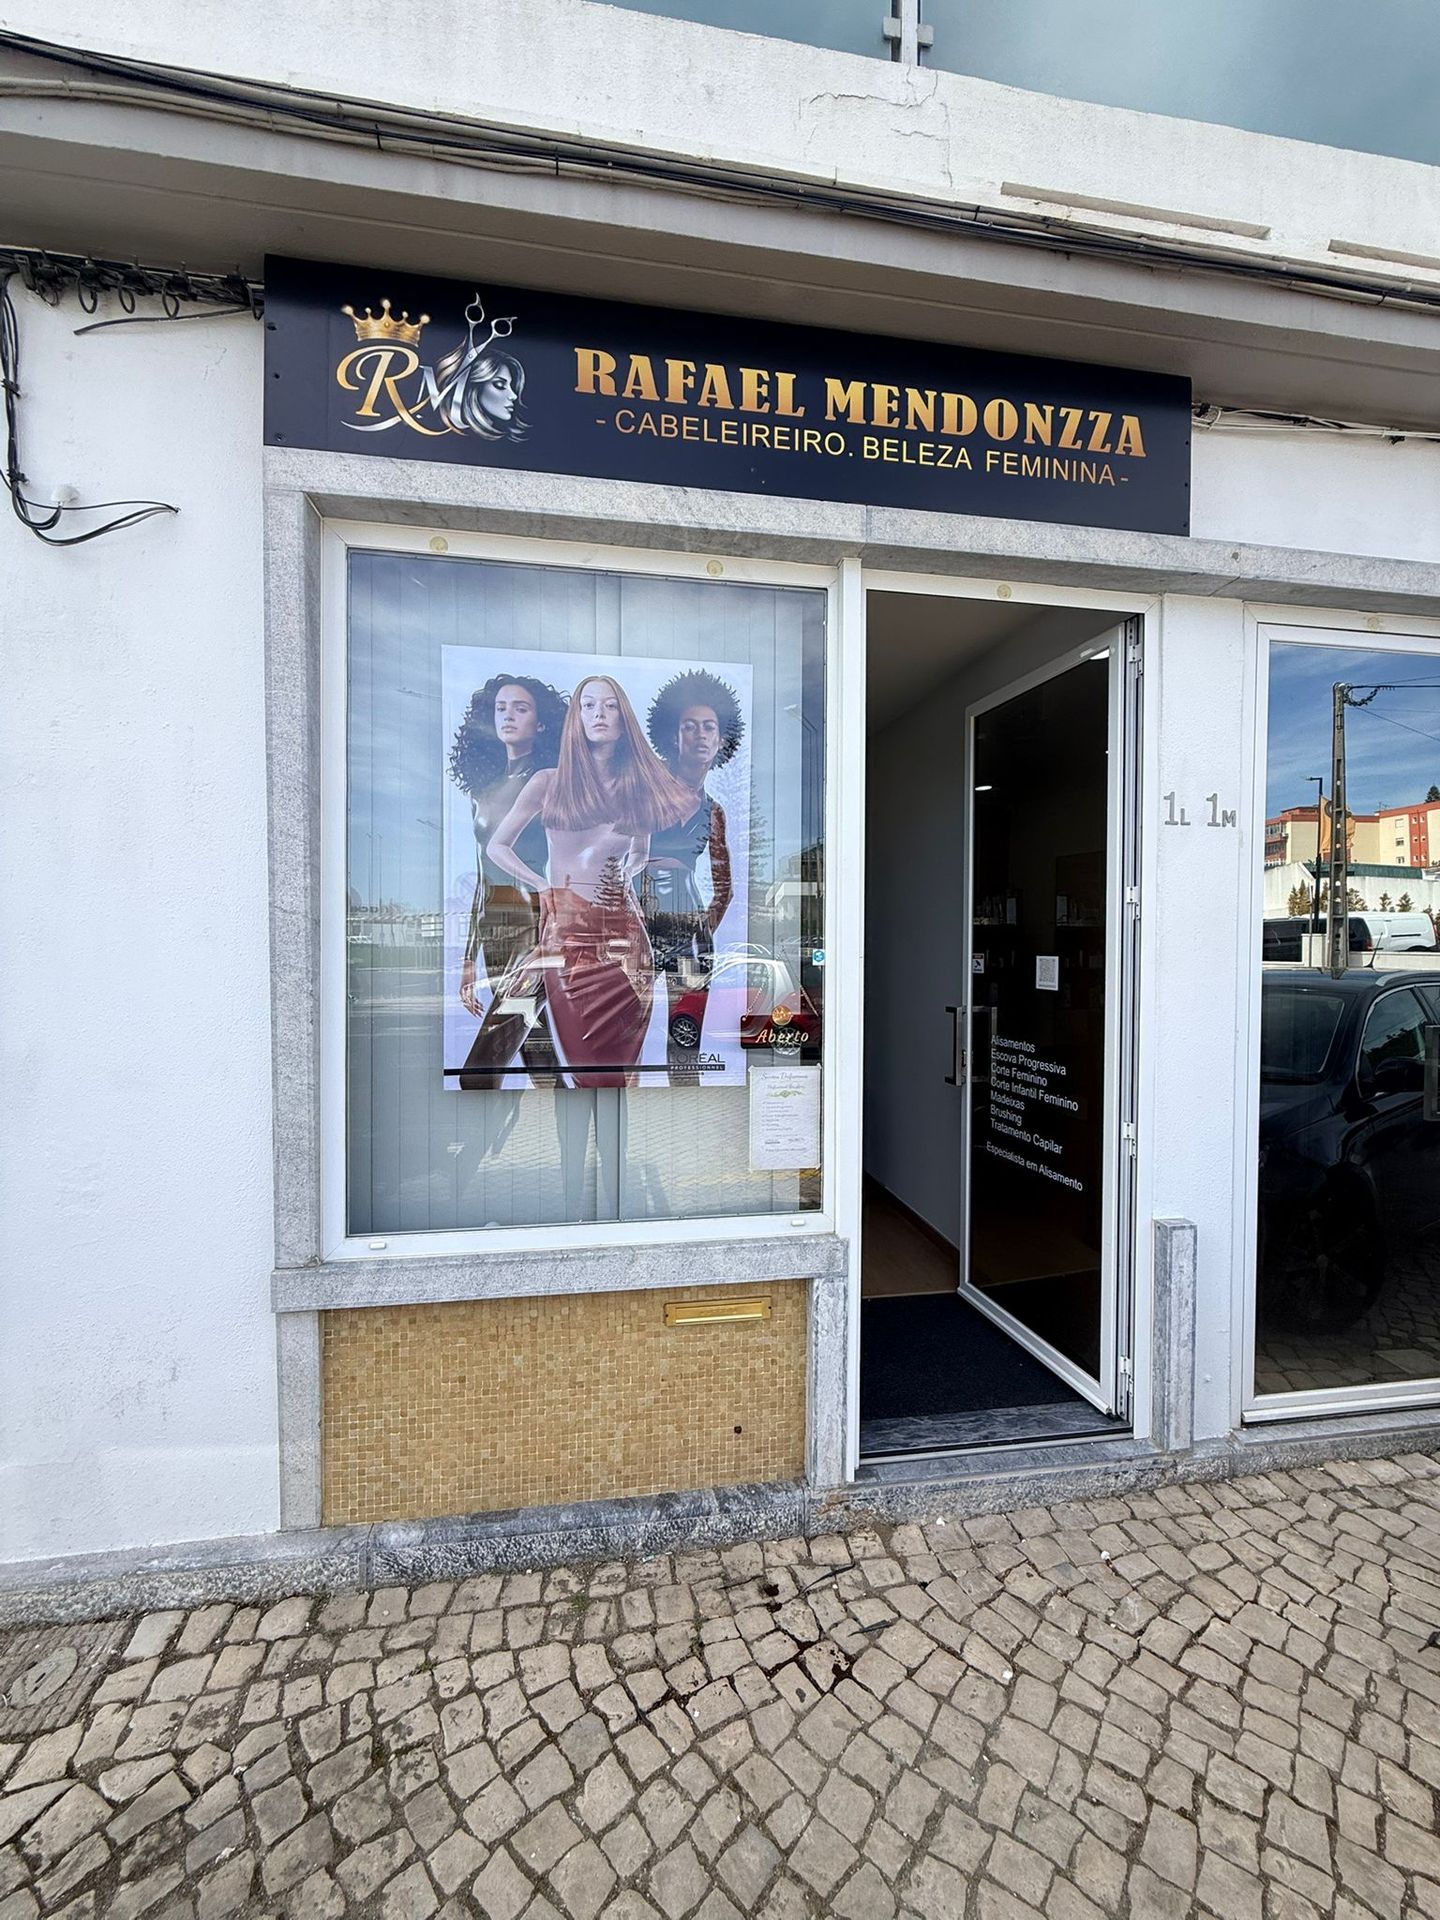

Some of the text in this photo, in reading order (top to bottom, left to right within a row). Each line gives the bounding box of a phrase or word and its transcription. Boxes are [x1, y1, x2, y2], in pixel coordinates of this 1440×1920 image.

[574, 347, 1147, 458] RAFAEL MENDONZZA
[862, 436, 973, 471] BELEZA
[755, 1029, 809, 1043] Aberto
[991, 1034, 1036, 1053] Alisamentos
[991, 1047, 1067, 1075] Escova Progressiva
[991, 1062, 1048, 1087] Corte Feminino
[990, 1089, 1025, 1111] Madeixas
[991, 1076, 1079, 1112] Corte Infantil Feminino
[990, 1103, 1023, 1127] Brushing
[990, 1117, 1063, 1154] Tratamento Capilar
[986, 1140, 1083, 1192] Especialista em Alisamento
